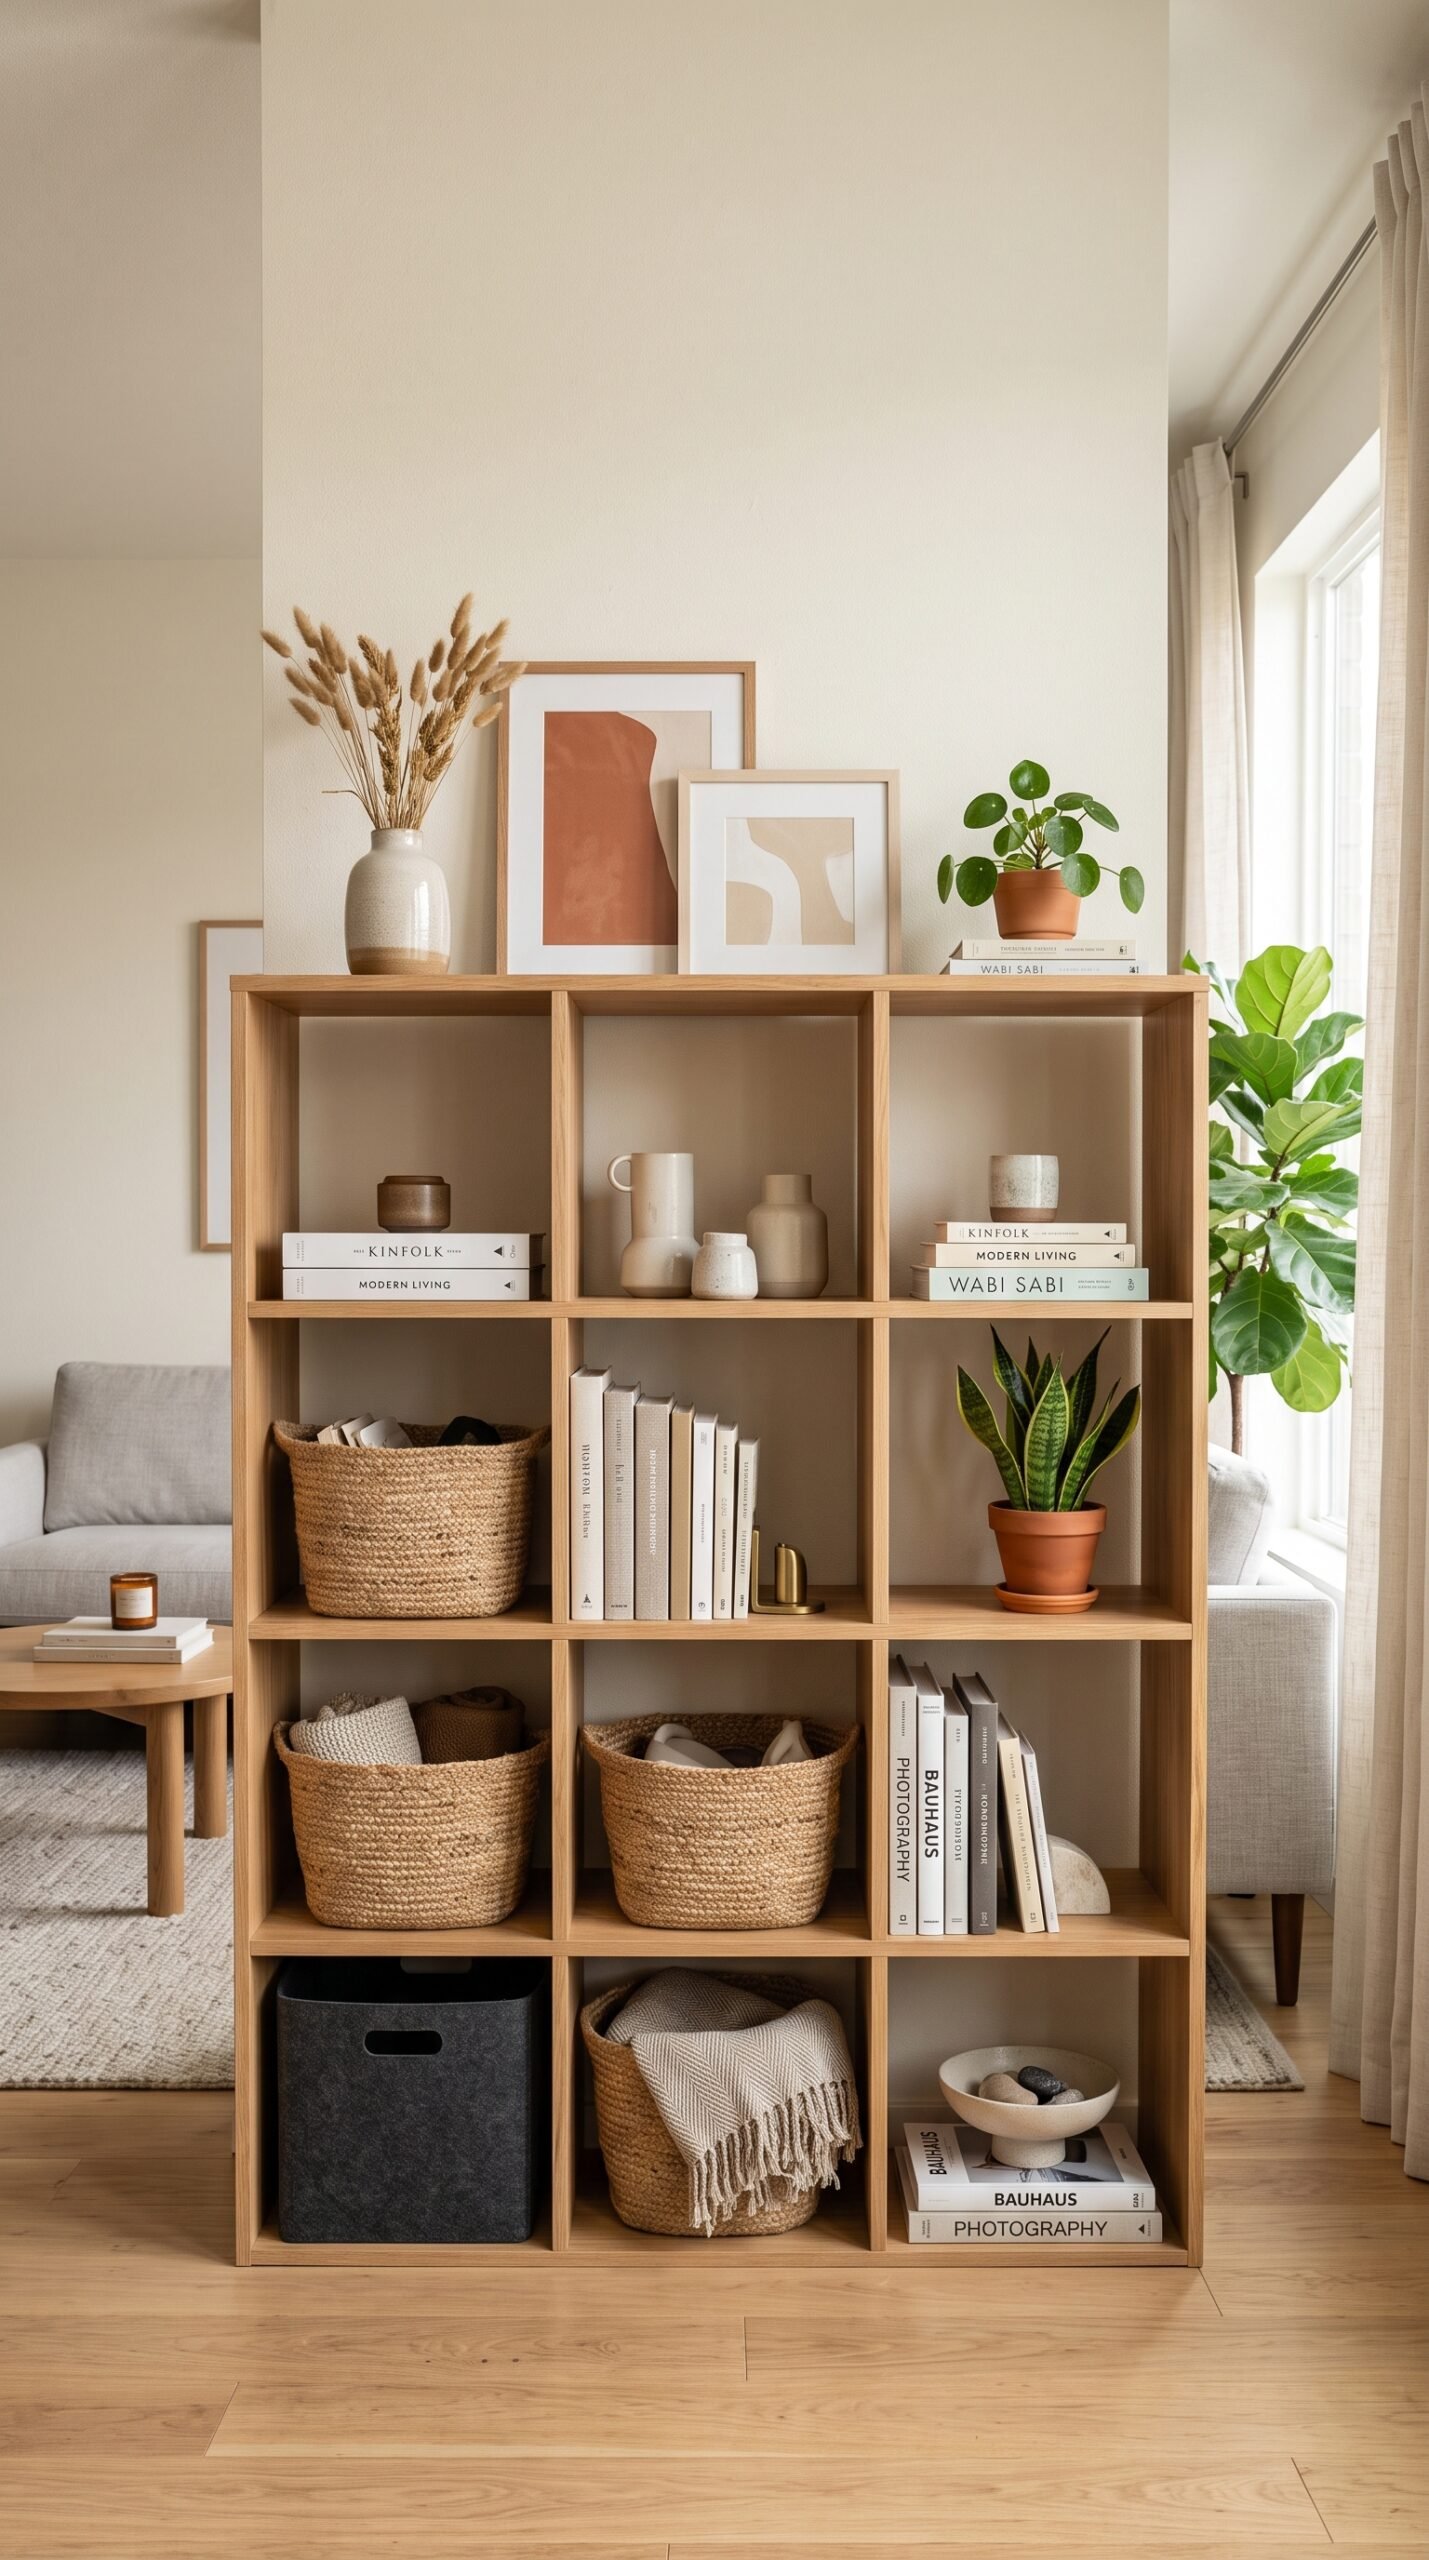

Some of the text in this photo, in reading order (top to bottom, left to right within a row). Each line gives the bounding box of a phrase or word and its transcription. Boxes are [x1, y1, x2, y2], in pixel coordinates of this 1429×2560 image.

[980, 964, 1043, 974] WABI SABI
[968, 1228, 1030, 1239] KINFOLK
[368, 1245, 444, 1258] KINFOLK
[976, 1251, 1077, 1261] MODERN LIVING
[358, 1280, 451, 1290] MODERN LIVING
[948, 1276, 1063, 1293] WABI SABI
[896, 1757, 911, 1883] PHOTOGRAPHY
[924, 1769, 939, 1859] BAUHAUS
[920, 2130, 947, 2175] BAUHAUS
[994, 2192, 1078, 2207] BAUHAUS
[954, 2220, 1108, 2237] PHOTOGRAPHY
